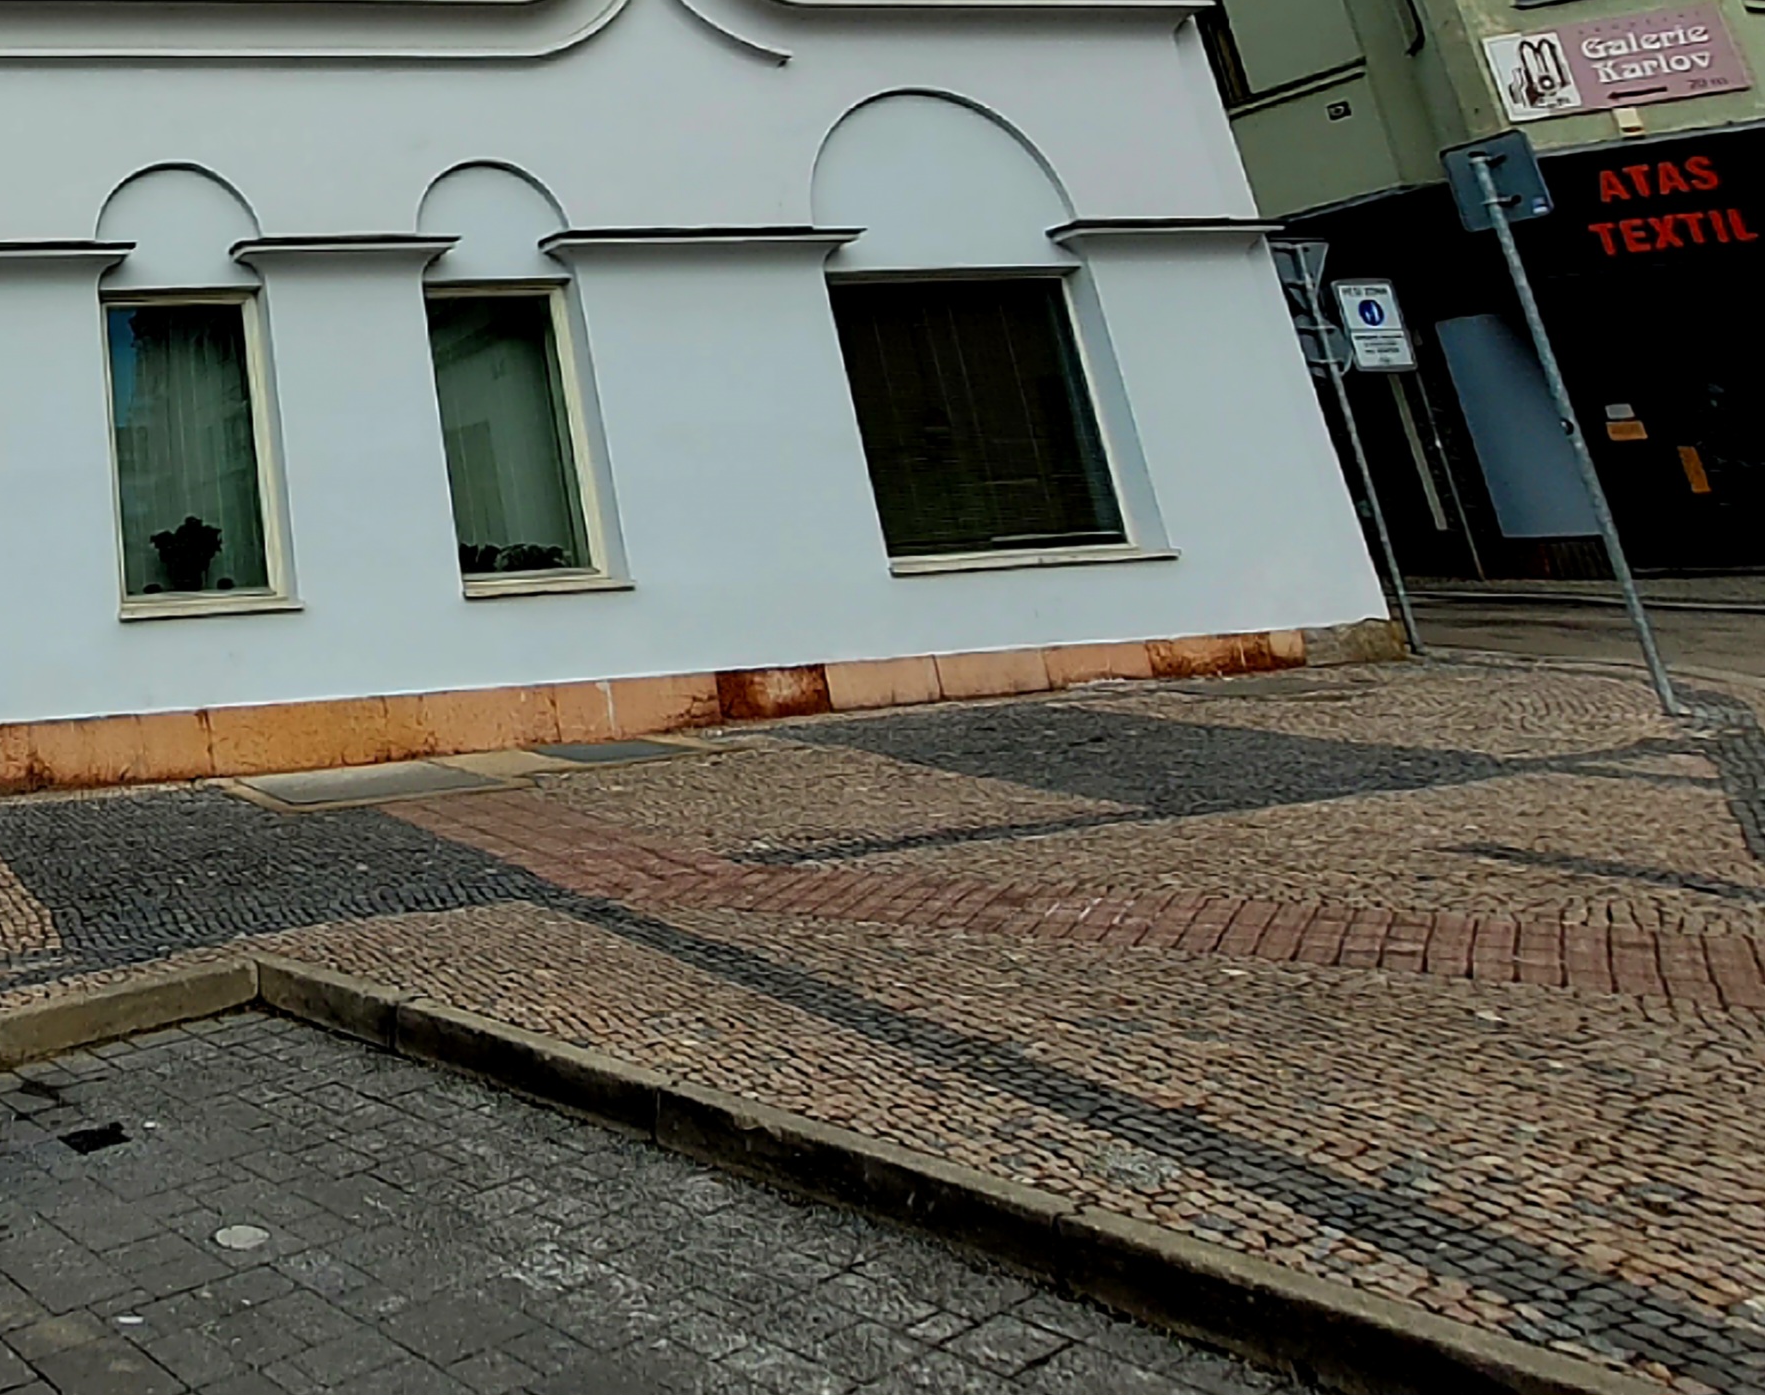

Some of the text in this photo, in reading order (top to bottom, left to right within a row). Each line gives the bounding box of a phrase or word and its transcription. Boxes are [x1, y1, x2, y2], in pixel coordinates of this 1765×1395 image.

[1581, 24, 1711, 59] Galerie
[1591, 51, 1712, 83] Karlov
[1599, 156, 1720, 203] ATAS
[1588, 208, 1759, 256] TEXTIL
